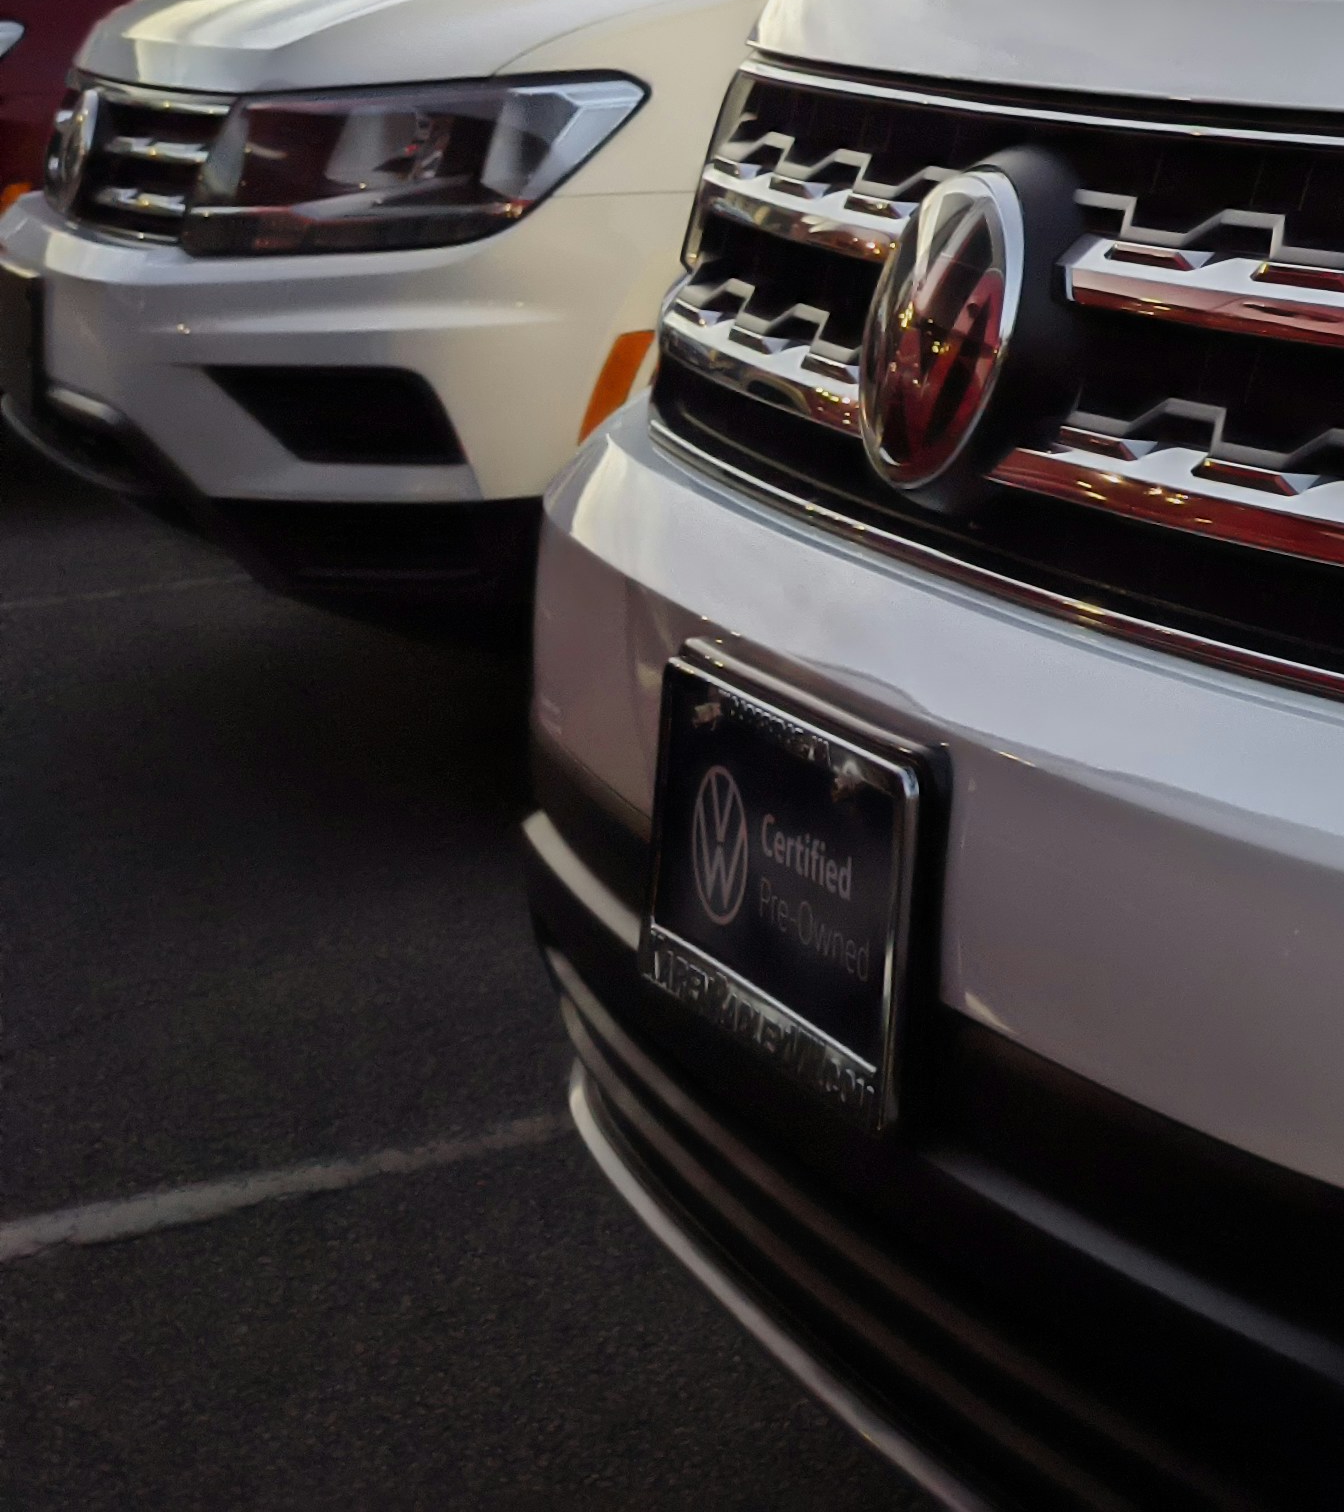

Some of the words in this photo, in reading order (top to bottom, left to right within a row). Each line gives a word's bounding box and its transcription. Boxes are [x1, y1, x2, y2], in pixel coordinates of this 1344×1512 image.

[692, 765, 748, 926] VW
[760, 812, 853, 901] Certified
[758, 877, 870, 983] Pre-Owned
